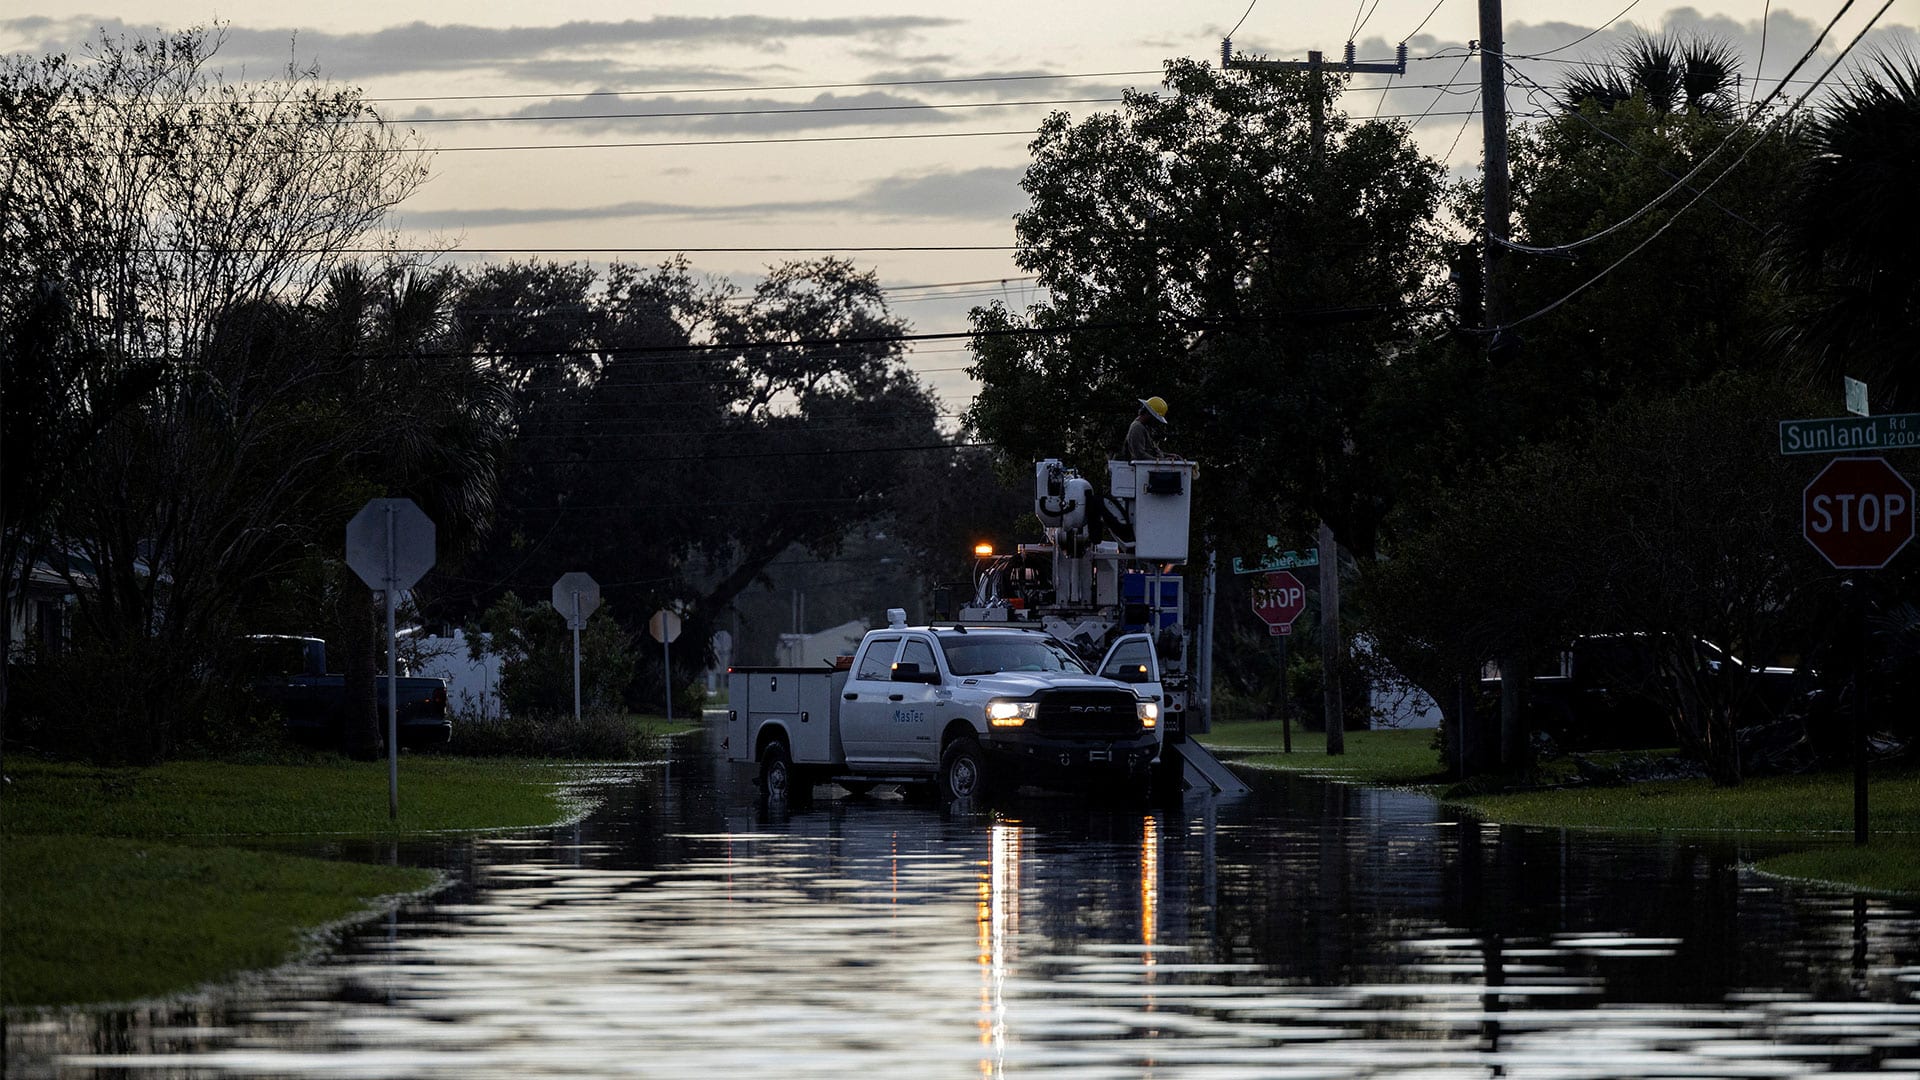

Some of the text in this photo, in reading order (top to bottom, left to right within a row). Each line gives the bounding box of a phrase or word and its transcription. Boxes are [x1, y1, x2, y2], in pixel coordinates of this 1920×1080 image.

[1787, 417, 1906, 450] Sunland Rd
[1811, 493, 1906, 534] STOP
[1256, 587, 1301, 609] STOP
[894, 709, 924, 723] MasTec
[1069, 705, 1112, 713] RAM
